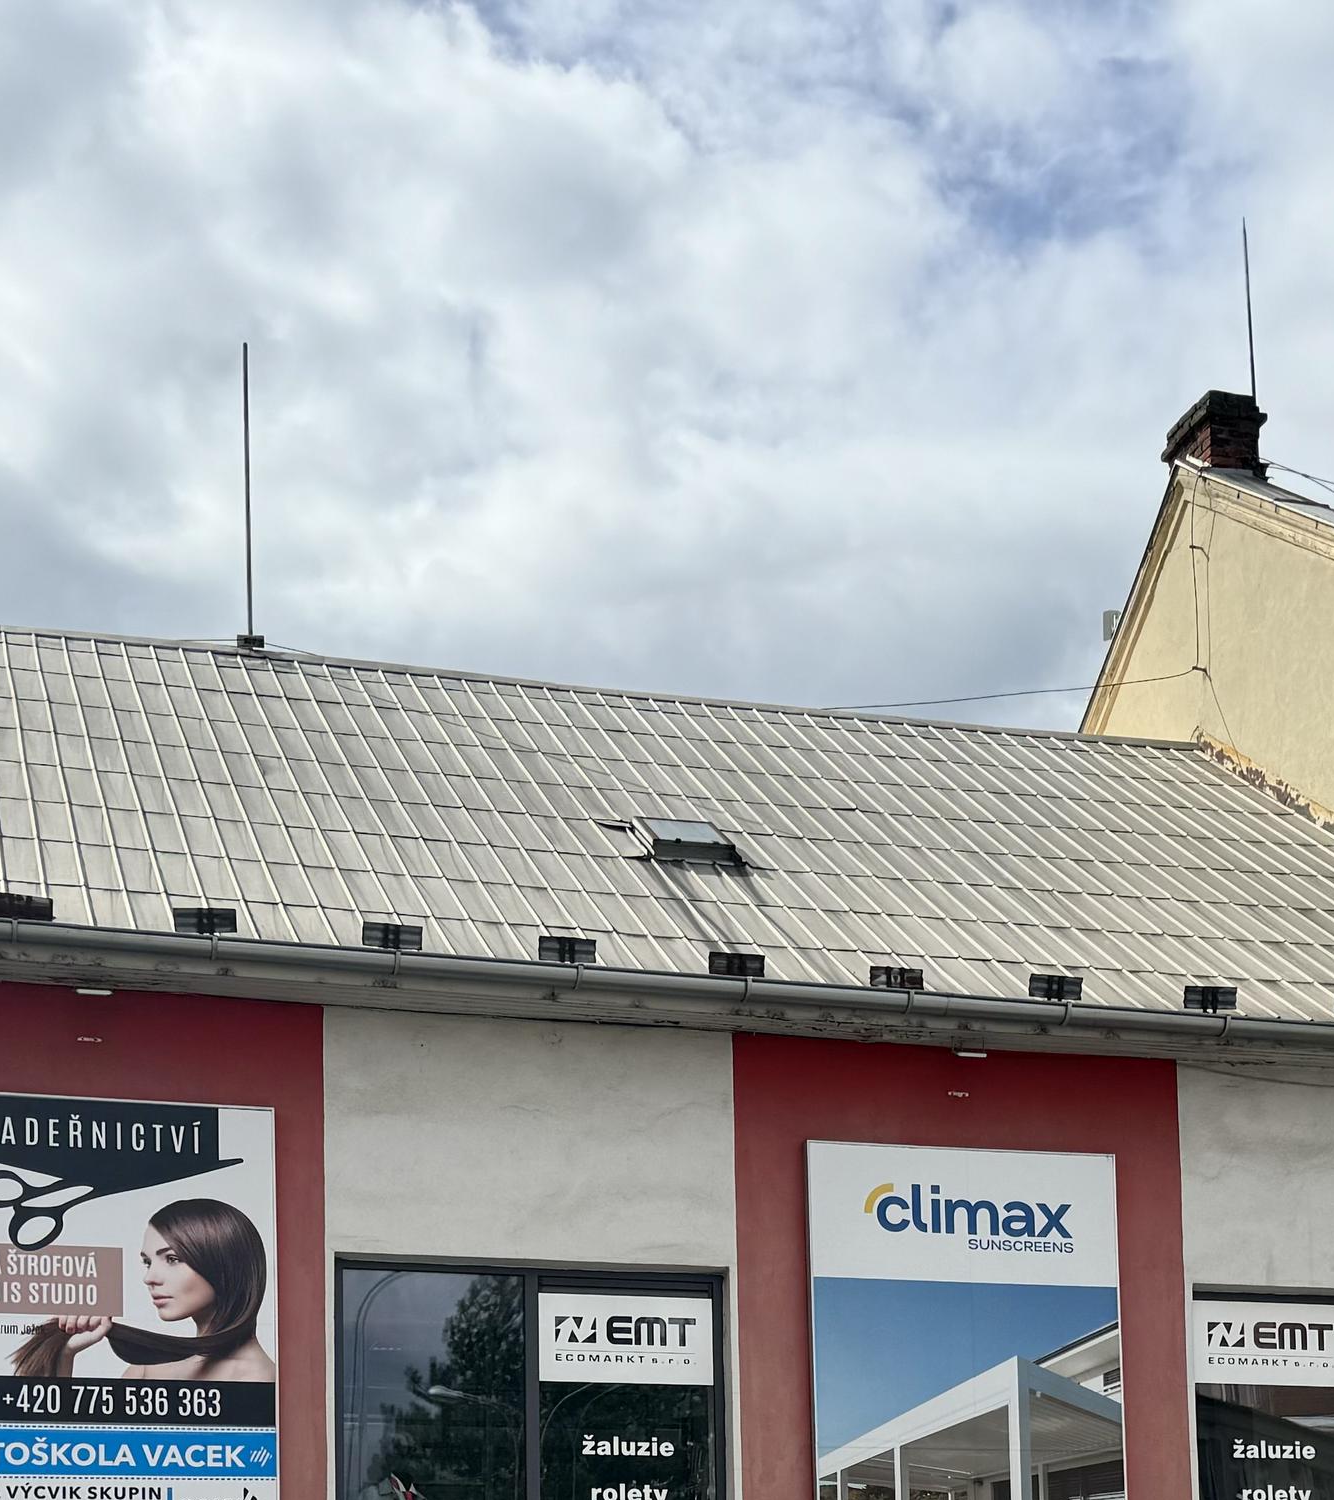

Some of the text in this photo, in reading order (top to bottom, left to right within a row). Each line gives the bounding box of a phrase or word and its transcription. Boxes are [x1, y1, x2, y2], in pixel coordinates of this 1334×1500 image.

[876, 1183, 1072, 1238] climax
[968, 1237, 1074, 1254] SUNSCREENS
[7, 1249, 97, 1278] ŠTROFOVÁ
[29, 1282, 97, 1306] STUDIO
[606, 1316, 696, 1347] EMT
[1253, 1321, 1333, 1352] EMT
[555, 1353, 645, 1364] ECOMARKT
[1208, 1356, 1288, 1367] ECOMARKT
[3, 1384, 221, 1417] +420 775 536 363
[142, 1445, 245, 1467] VACEK
[582, 1435, 675, 1457] žaluzie
[1232, 1438, 1316, 1460] žaluzie
[6, 1483, 81, 1500] VÝCVIK
[87, 1486, 161, 1500] SKUPIN
